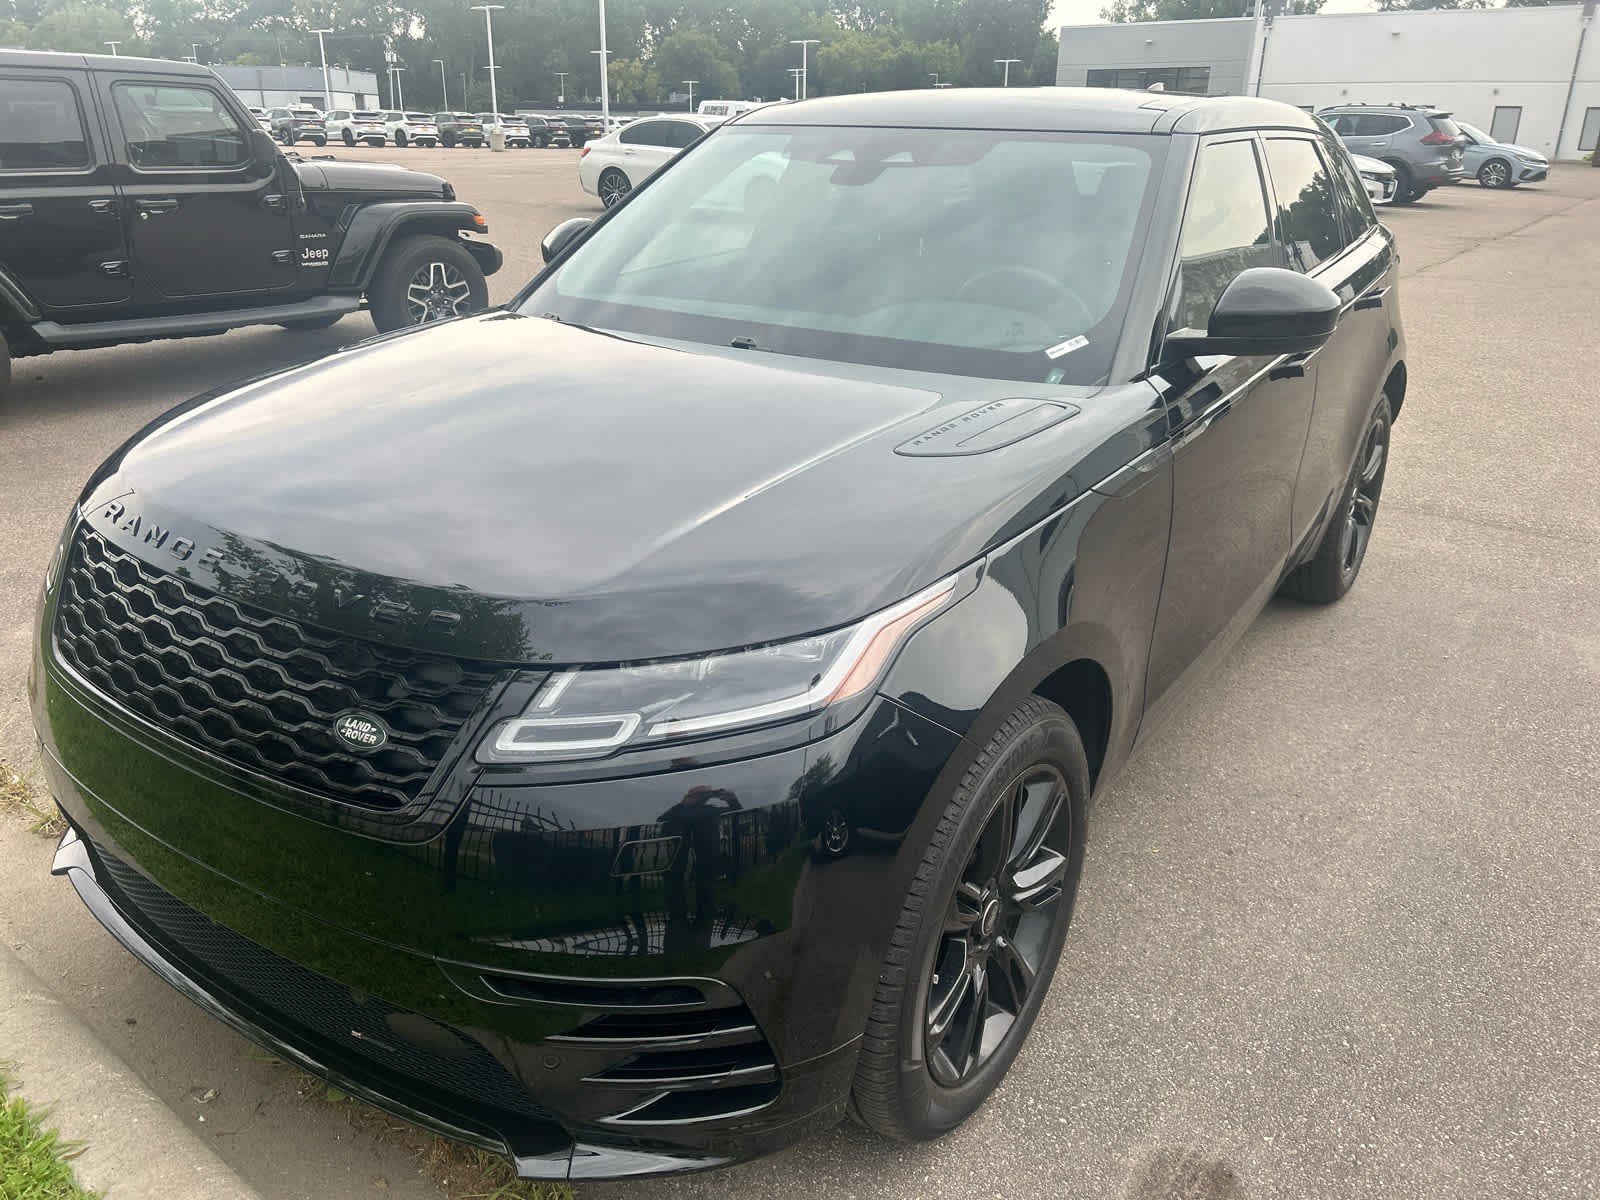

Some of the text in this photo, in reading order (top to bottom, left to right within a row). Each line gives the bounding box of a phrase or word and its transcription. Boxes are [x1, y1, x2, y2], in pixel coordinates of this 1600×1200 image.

[300, 247, 329, 260] Jeep
[912, 402, 1004, 446] RANGE ROVER
[104, 501, 225, 574] RANGE
[344, 728, 377, 744] ROVER
